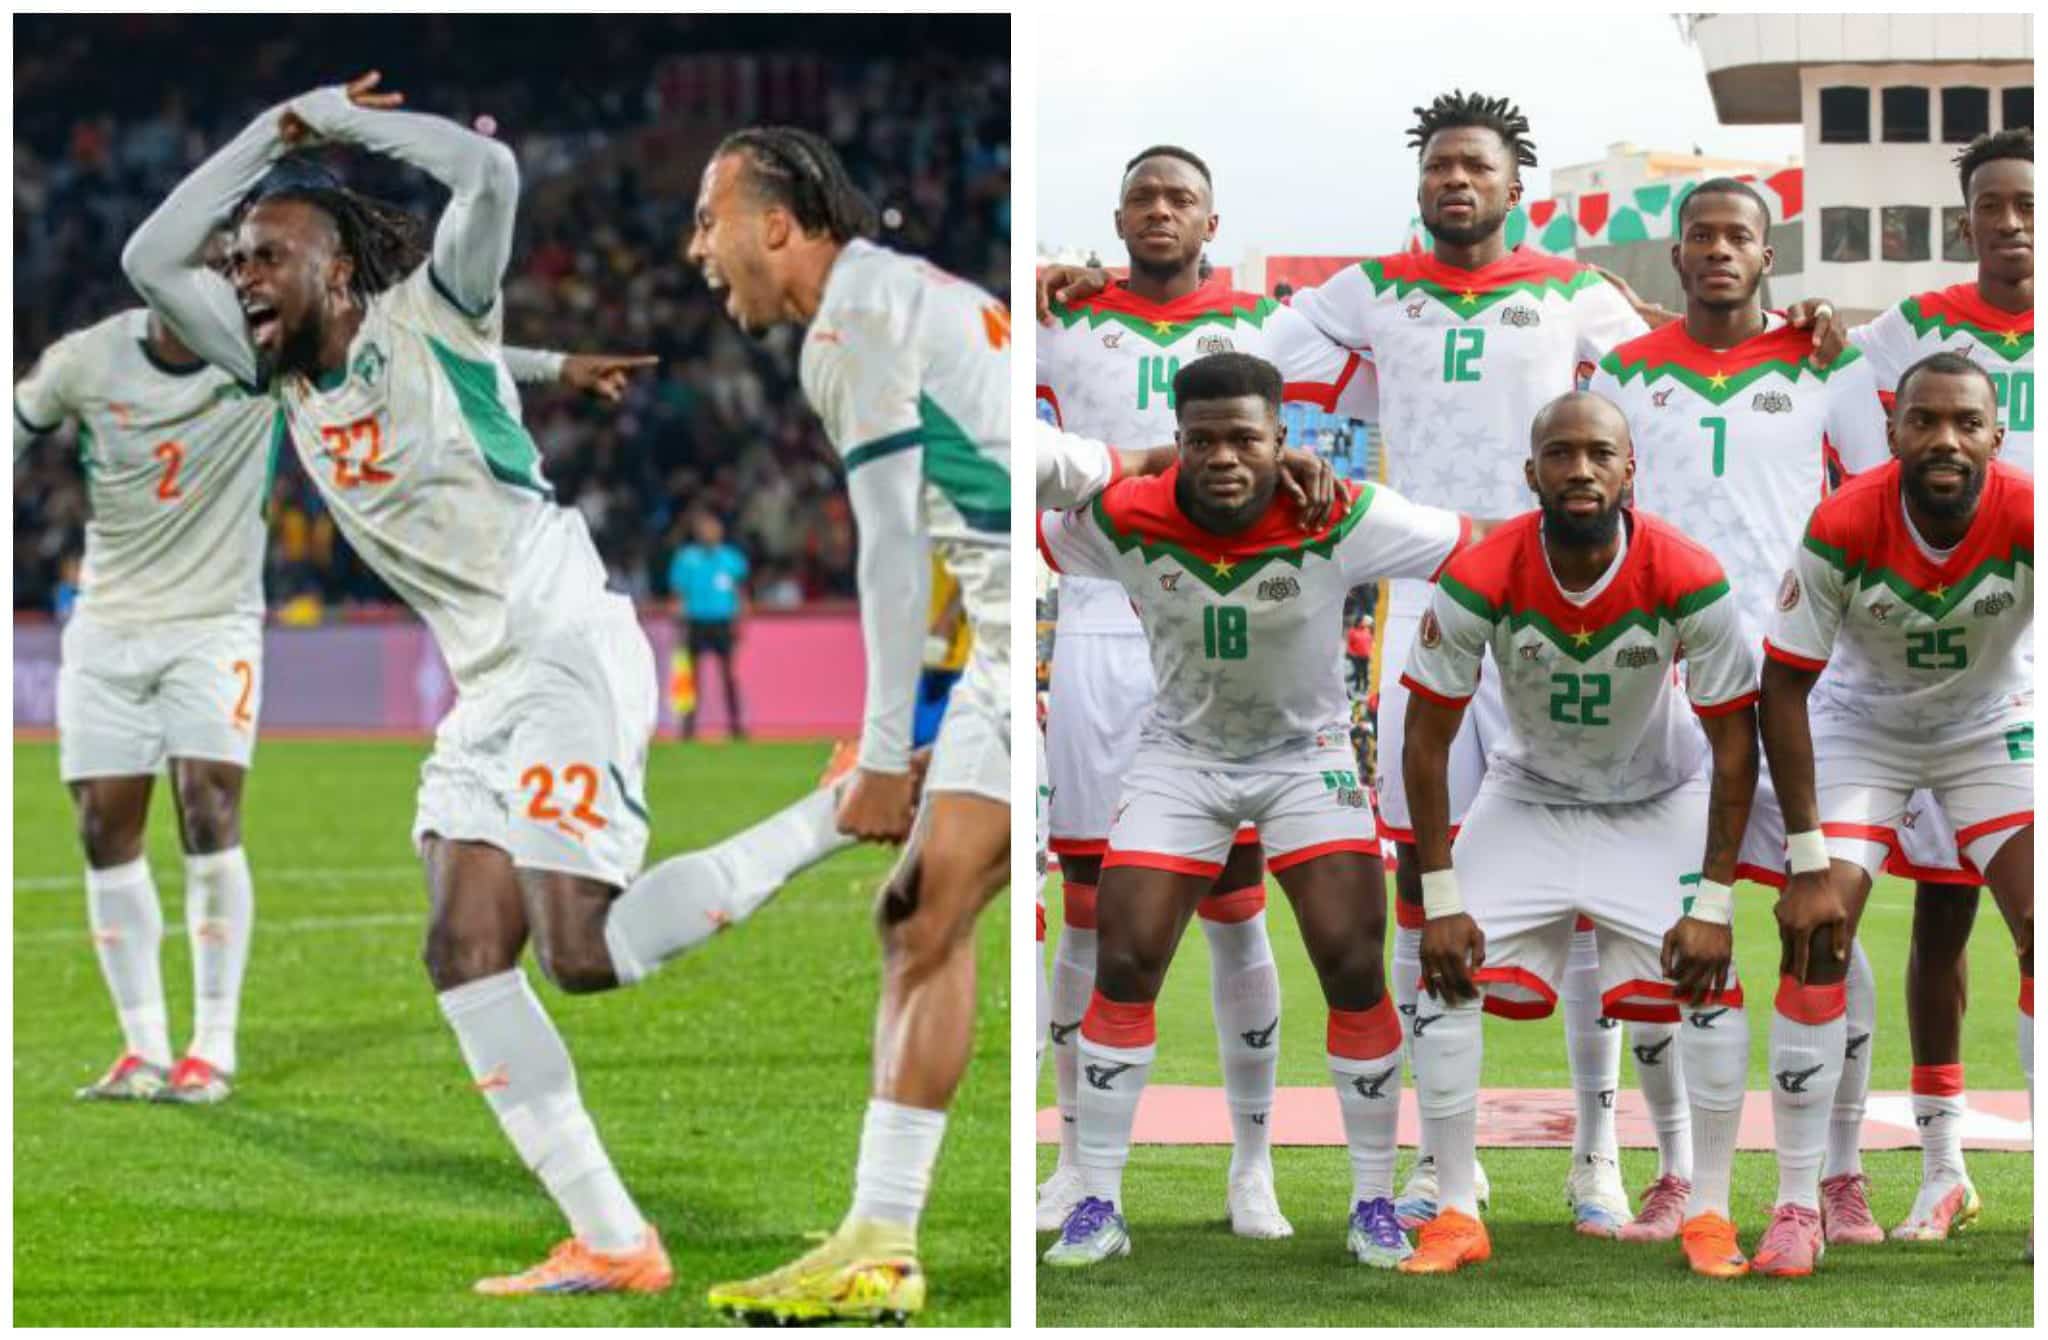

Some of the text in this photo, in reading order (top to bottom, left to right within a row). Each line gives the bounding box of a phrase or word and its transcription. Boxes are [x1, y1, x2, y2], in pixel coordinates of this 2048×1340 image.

[1137, 355, 1179, 410] 14
[1443, 328, 1485, 382] 12
[155, 442, 183, 500] 2
[321, 416, 395, 489] 22
[1699, 416, 1727, 477] 7
[1204, 605, 1249, 661] 18
[1906, 627, 1967, 670] 25
[233, 661, 253, 722] 2
[1550, 673, 1612, 726] 22
[520, 763, 608, 829] 22
